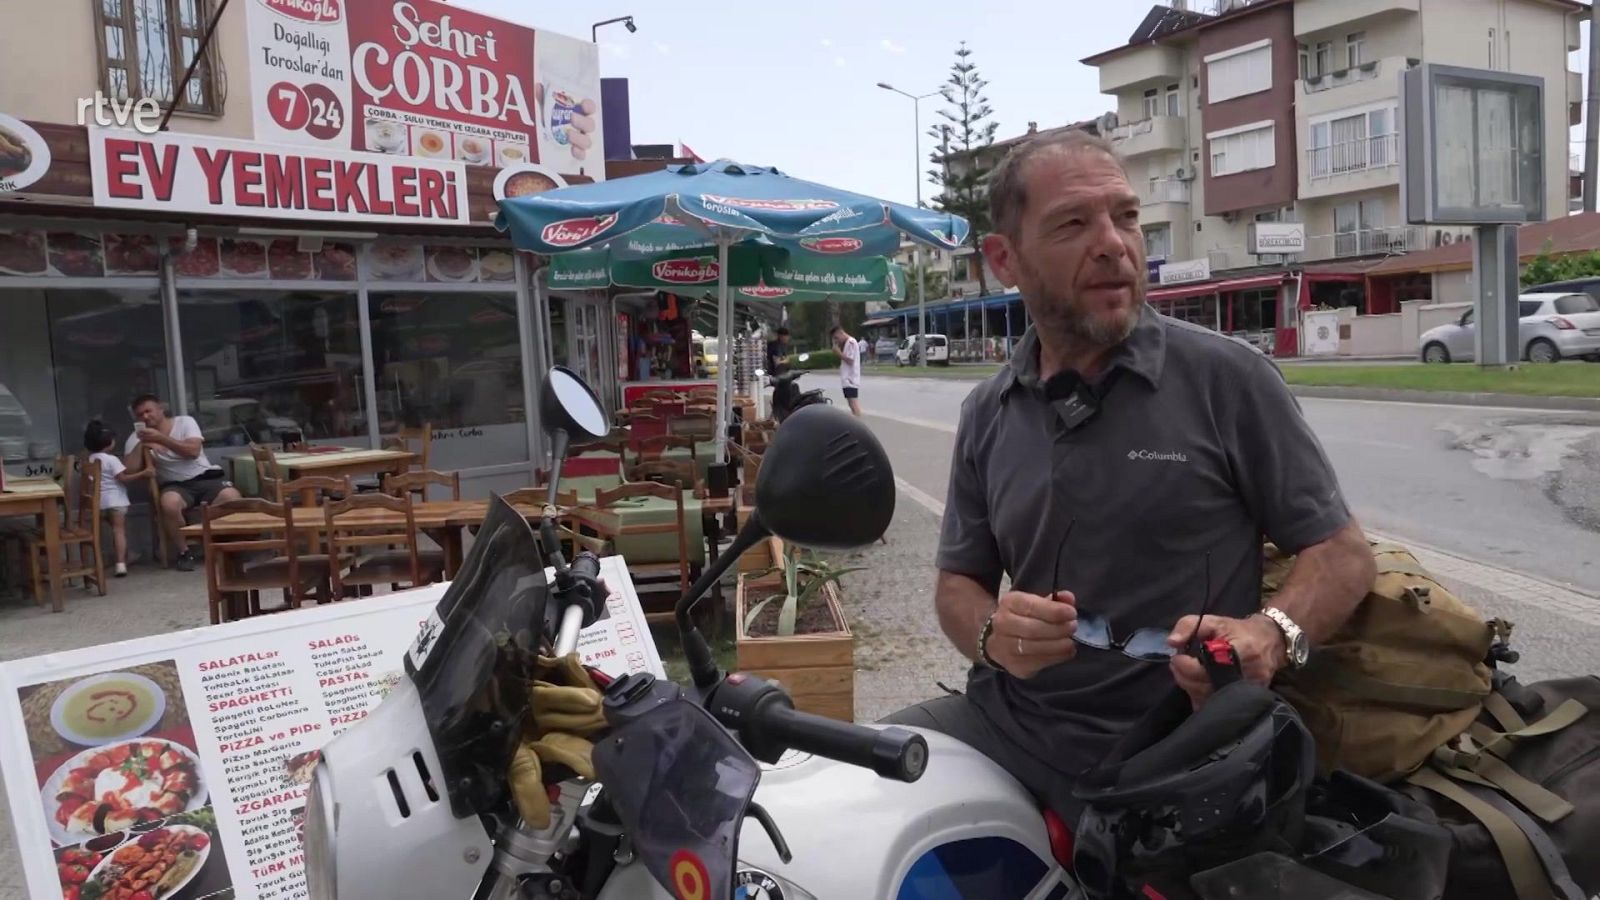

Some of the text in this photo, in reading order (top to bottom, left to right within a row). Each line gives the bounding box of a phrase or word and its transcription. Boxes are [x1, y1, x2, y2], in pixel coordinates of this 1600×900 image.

[274, 23, 330, 56] Doğallığı
[392, 2, 498, 62] Şehr-i
[262, 47, 344, 81] Toroslar'dan
[352, 42, 535, 126] ÇORBA
[279, 89, 341, 129] 7 24
[368, 109, 397, 120] ÇORBA
[404, 115, 424, 124] SULU
[426, 118, 451, 129] YEMEK
[454, 123, 464, 131] VE
[104, 138, 179, 201] EV
[1139, 449, 1187, 462] Columbia
